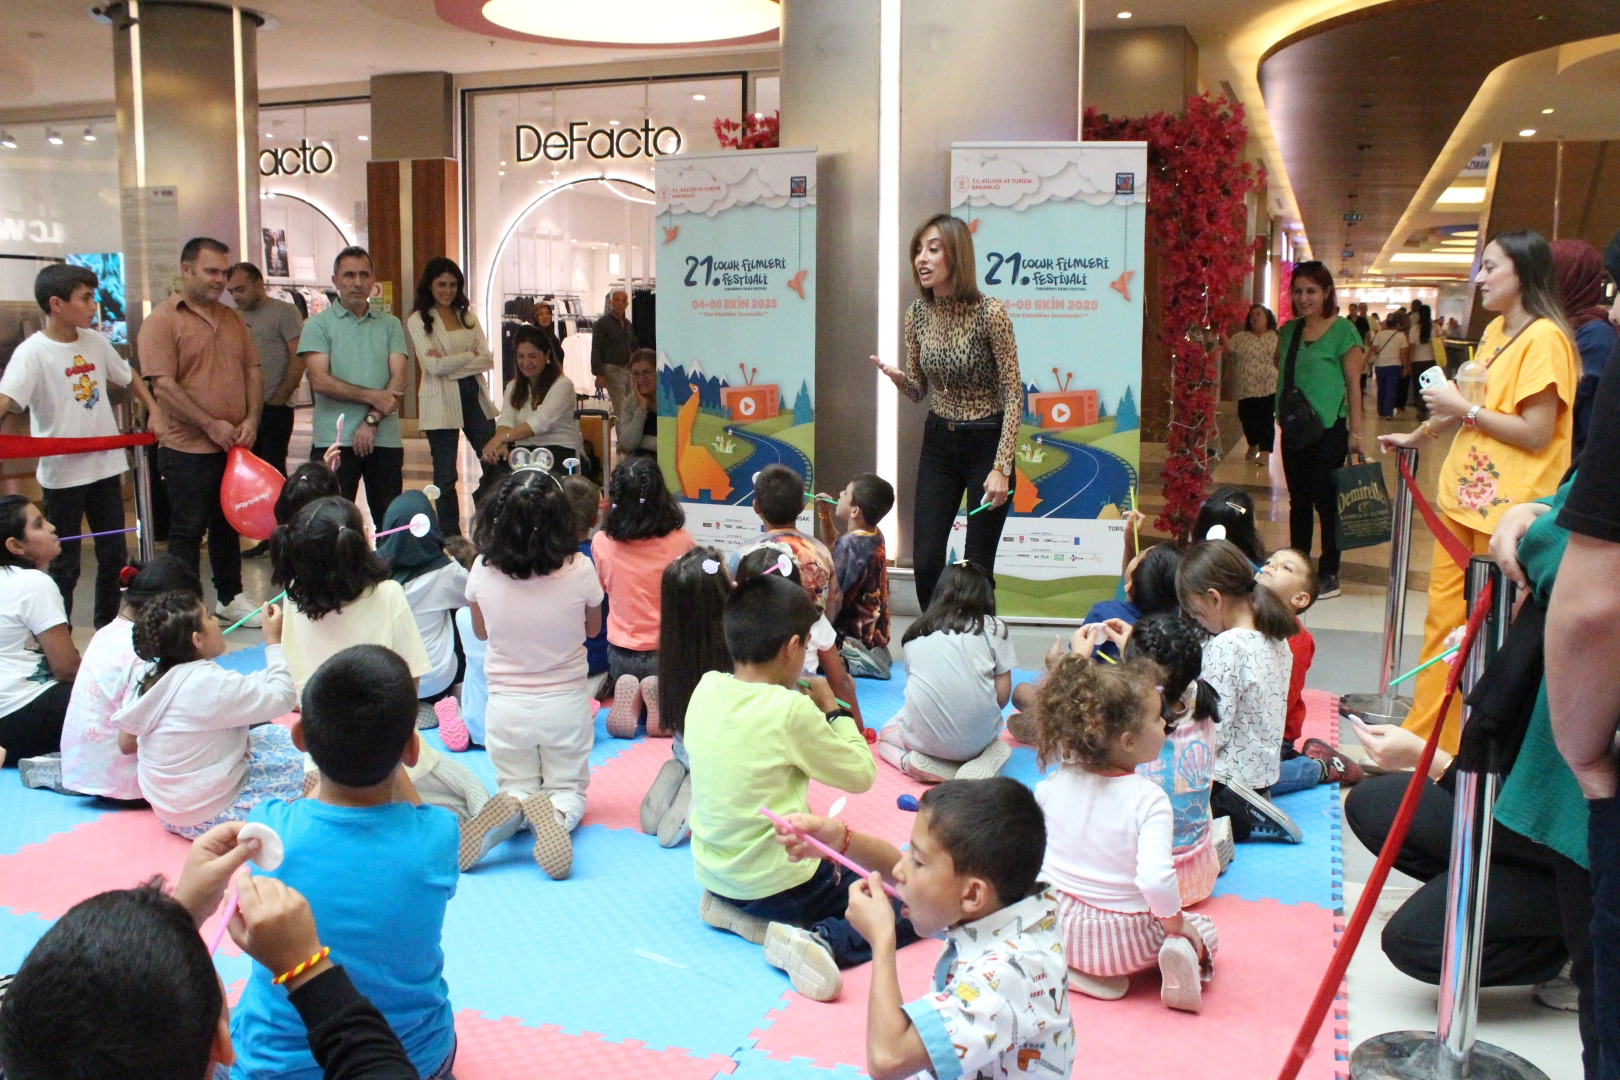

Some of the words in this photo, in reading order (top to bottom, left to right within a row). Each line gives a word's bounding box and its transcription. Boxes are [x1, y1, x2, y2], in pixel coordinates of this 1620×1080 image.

[516, 119, 682, 162] DeFacto
[260, 138, 333, 176] acto
[684, 255, 720, 286] 21.
[742, 258, 786, 272] FİLMLERİ
[722, 273, 768, 286] FESTİVALİ
[985, 252, 1030, 285] 21.
[1056, 257, 1109, 271] FİLMLERİ
[1032, 272, 1087, 285] FESTİVALİ
[692, 300, 722, 309] 04-08
[724, 296, 749, 309] EKİM
[1003, 299, 1032, 310] 4-08
[1034, 297, 1064, 310] EKİM
[1067, 300, 1097, 310] 2025
